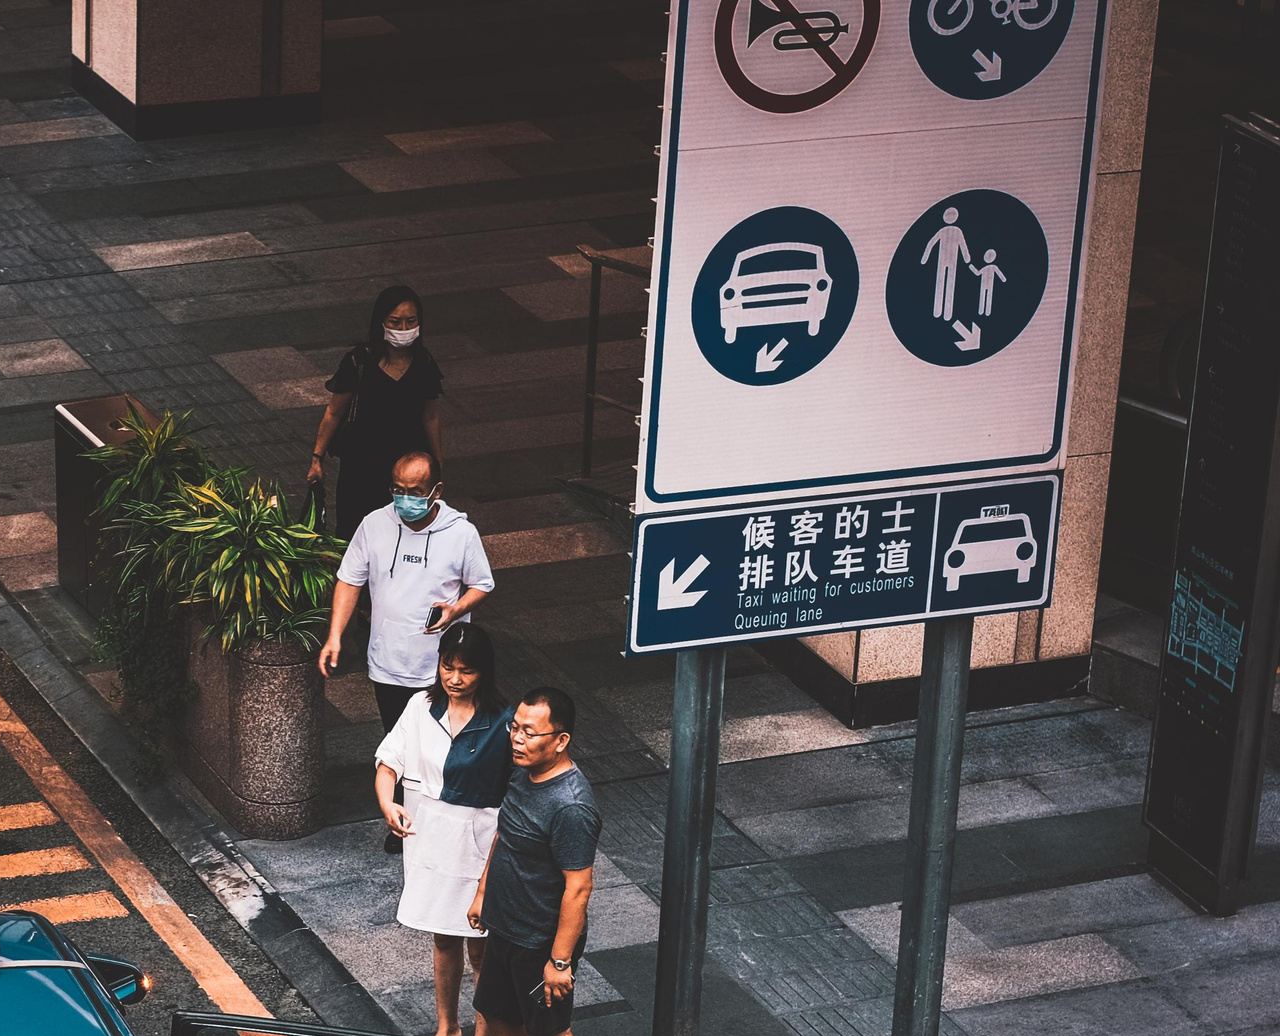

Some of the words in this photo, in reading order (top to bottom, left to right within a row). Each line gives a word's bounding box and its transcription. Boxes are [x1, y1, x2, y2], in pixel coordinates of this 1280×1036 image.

[742, 501, 915, 552] 候客的士
[403, 554, 422, 564] FRESH
[739, 539, 911, 591] 排队车道
[737, 591, 763, 609] Taxi
[772, 586, 816, 604] waiting
[825, 581, 842, 597] for
[850, 576, 914, 594] customers
[735, 611, 788, 629] Queuing
[796, 607, 822, 622] lane
